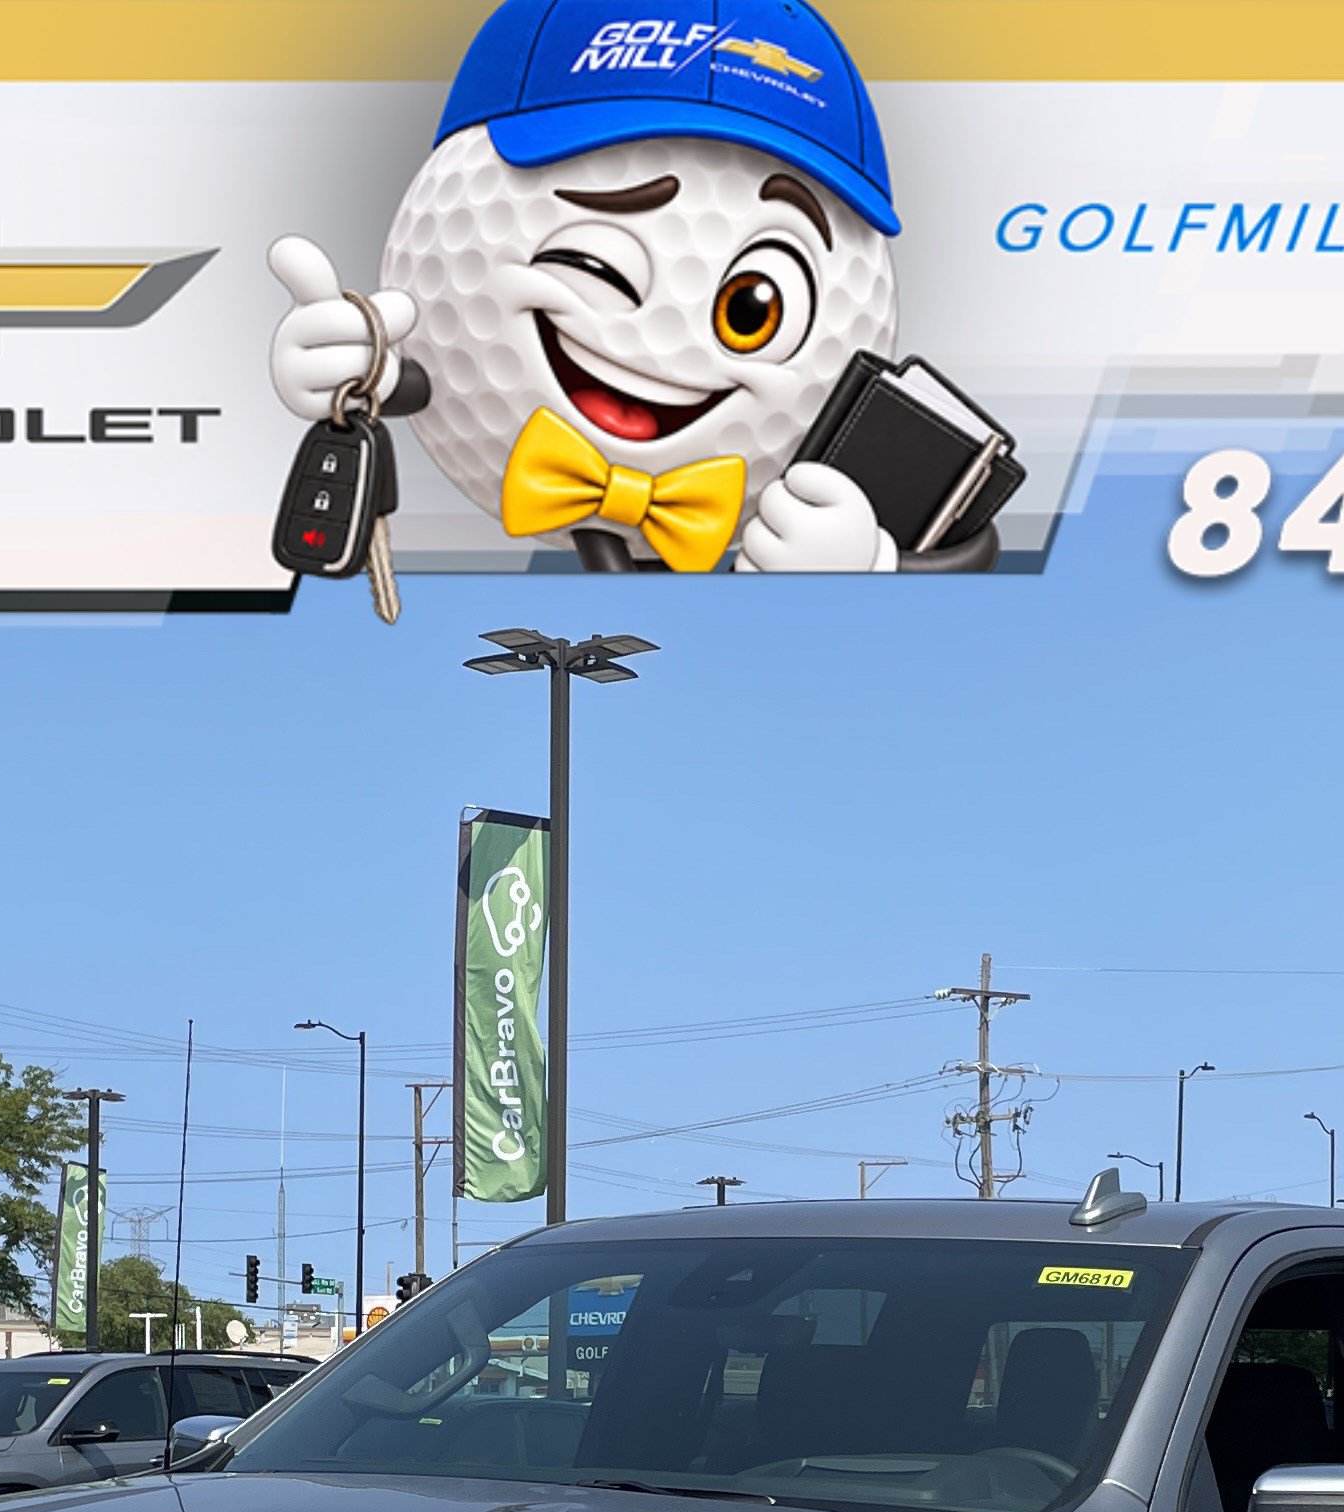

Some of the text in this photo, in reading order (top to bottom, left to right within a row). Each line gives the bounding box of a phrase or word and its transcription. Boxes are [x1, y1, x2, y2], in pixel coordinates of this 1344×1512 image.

[489, 968, 526, 1163] CarBravo
[68, 1229, 88, 1314] CarBravo
[1045, 1271, 1125, 1286] GM6810
[575, 1346, 609, 1360] GOLF
